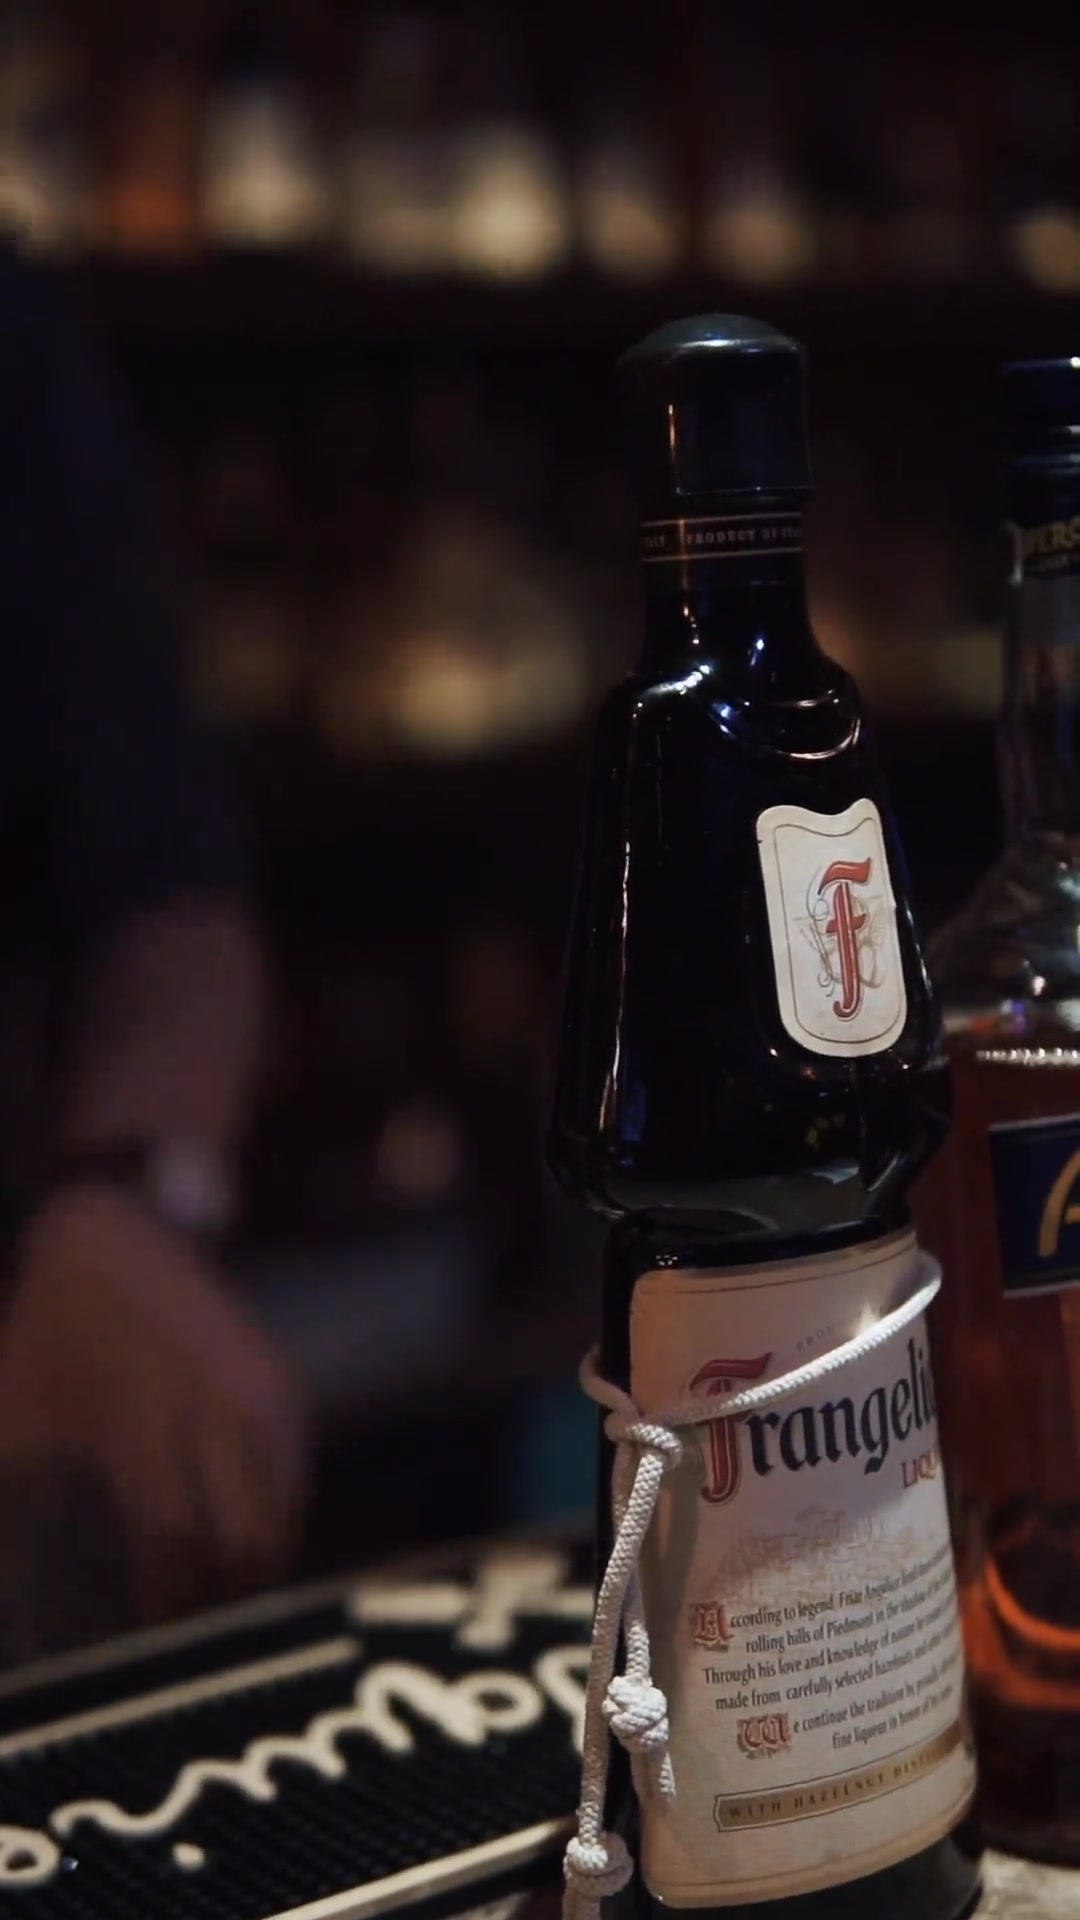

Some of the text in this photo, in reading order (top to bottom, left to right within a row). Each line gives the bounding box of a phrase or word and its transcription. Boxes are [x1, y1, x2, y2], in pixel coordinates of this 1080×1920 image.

[784, 1607, 797, 1620] to
[797, 1594, 834, 1620] legend
[745, 1634, 785, 1654] rolling
[786, 1626, 811, 1646] hills
[813, 1624, 825, 1640] of
[827, 1612, 874, 1639] Piedmont
[703, 1663, 756, 1687] Through
[758, 1661, 776, 1679] his
[778, 1656, 802, 1673] love
[804, 1650, 825, 1668] and
[827, 1636, 879, 1665] knowledge
[715, 1691, 750, 1711] made
[752, 1687, 781, 1706] from
[786, 1675, 833, 1701] carefully
[835, 1661, 873, 1688] selected
[802, 1707, 848, 1733] continue
[849, 1698, 865, 1718] the
[832, 1731, 852, 1750] fine
[728, 1801, 782, 1819] WITH
